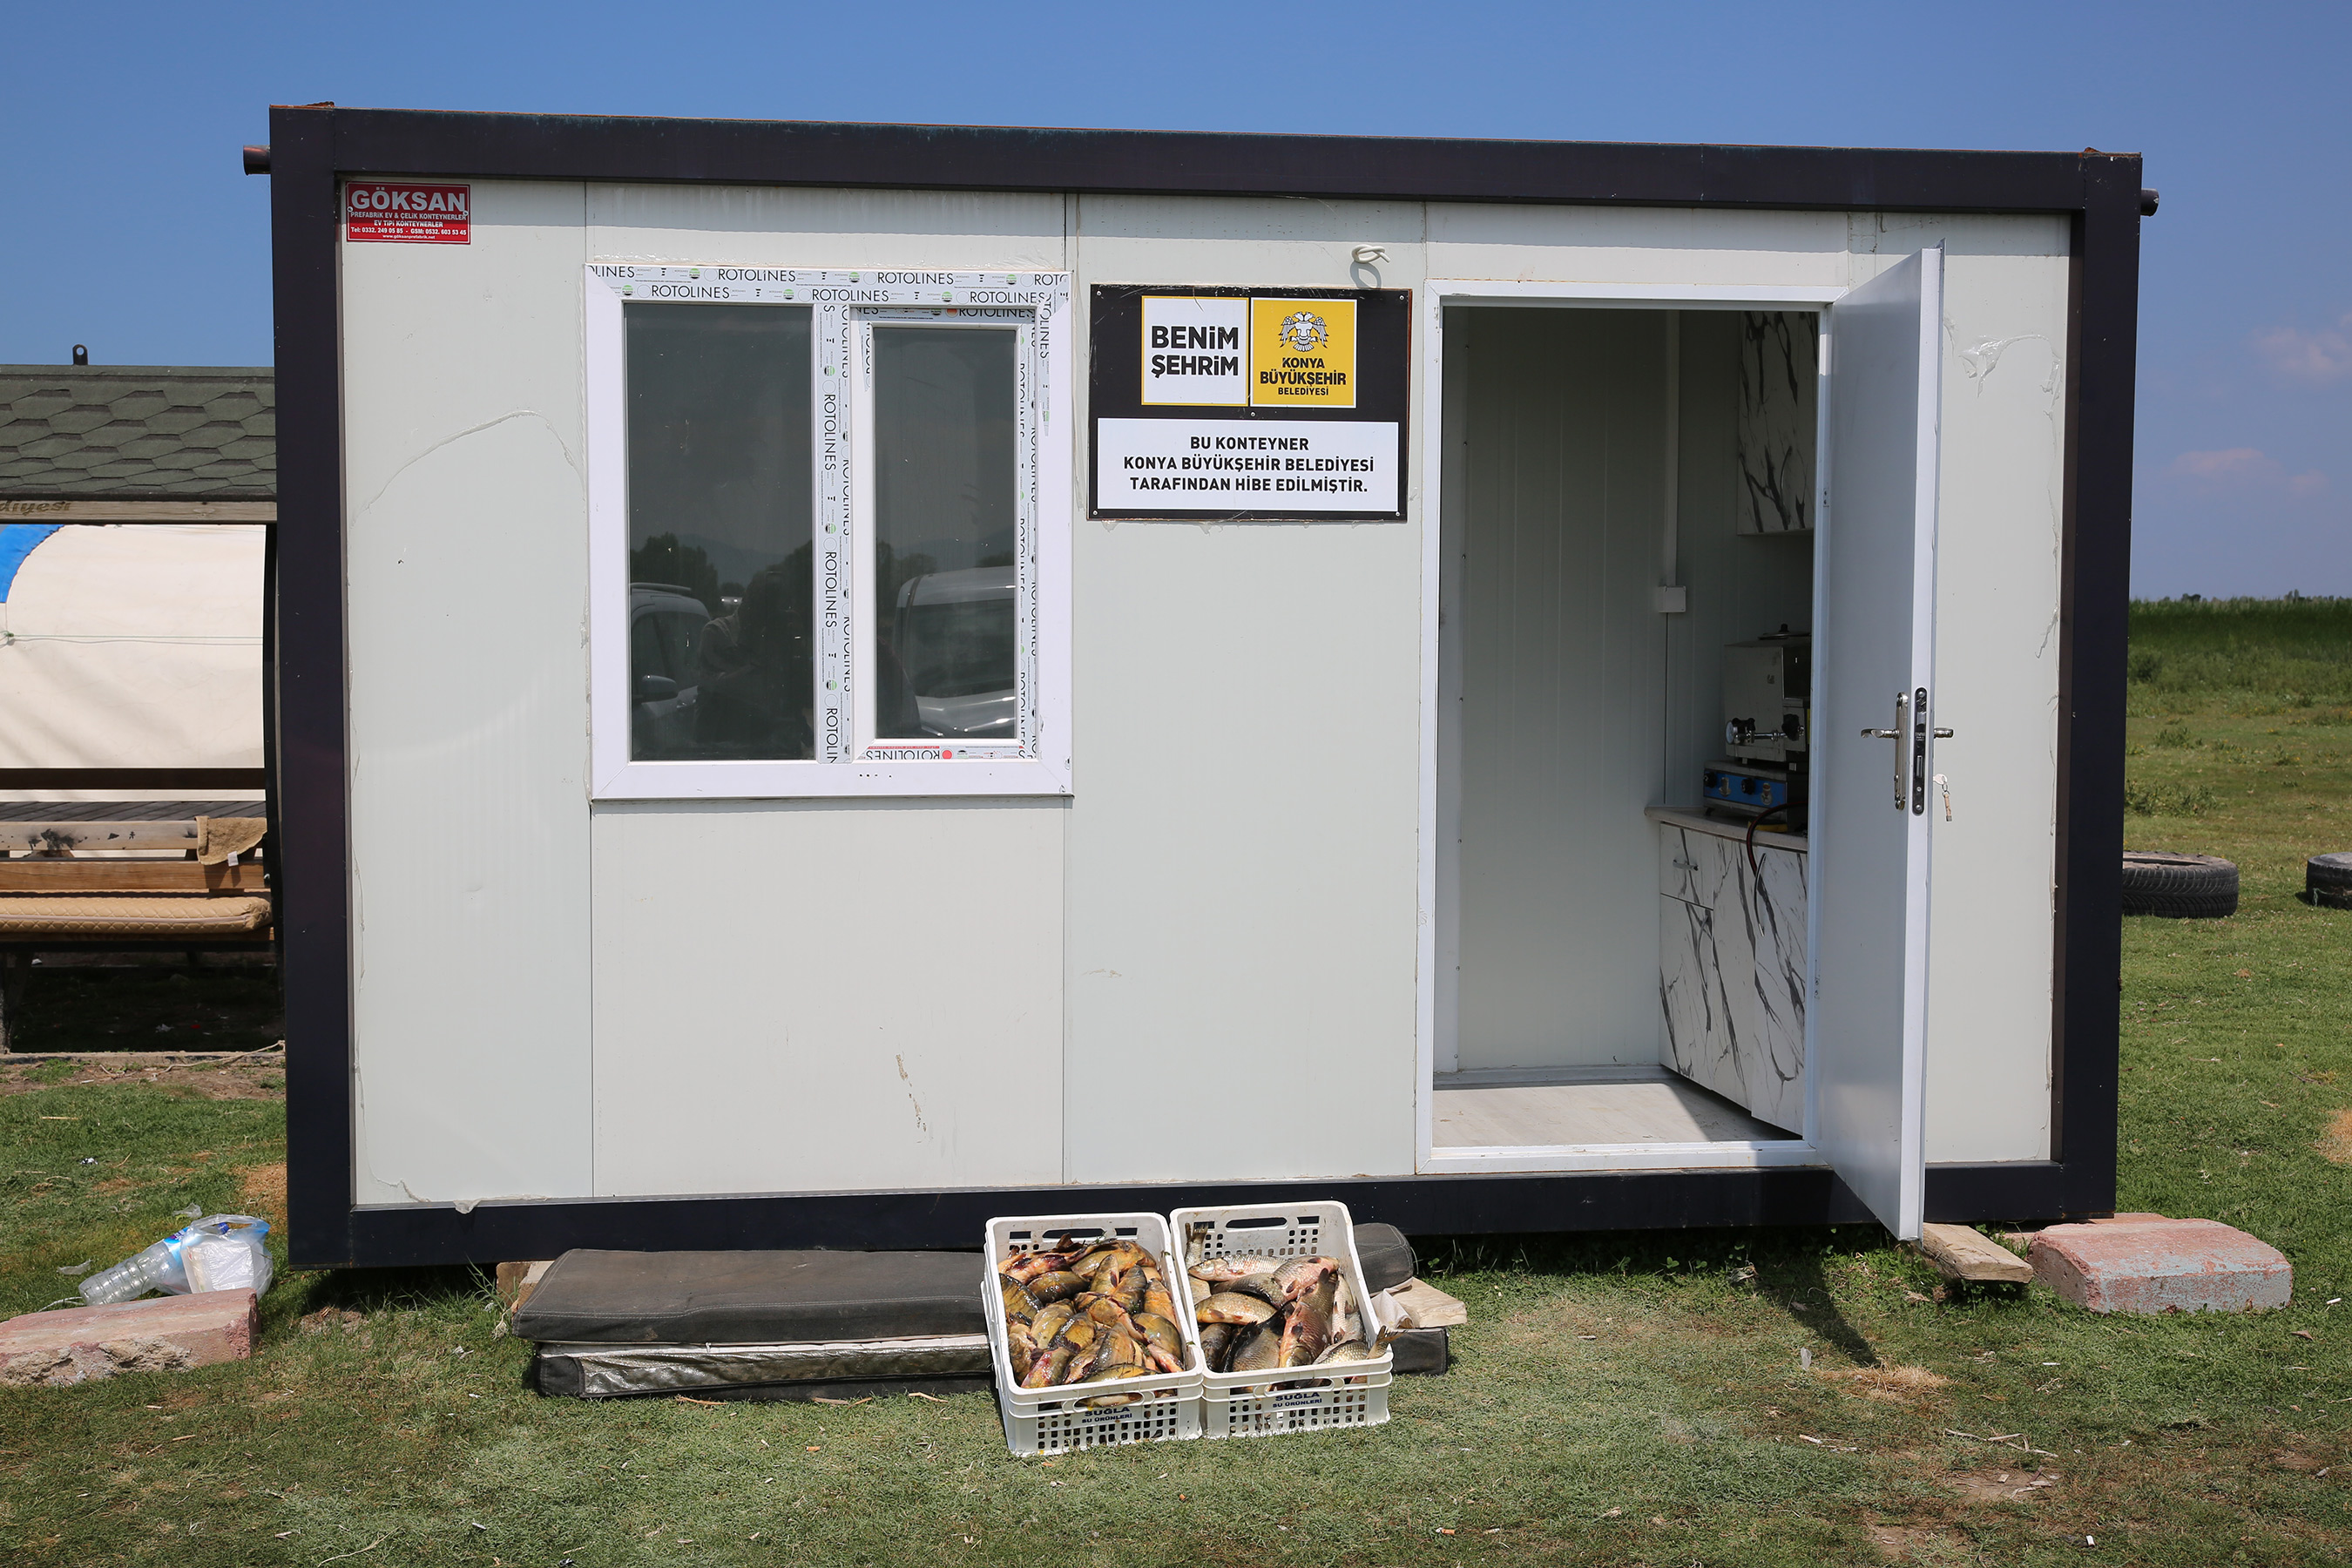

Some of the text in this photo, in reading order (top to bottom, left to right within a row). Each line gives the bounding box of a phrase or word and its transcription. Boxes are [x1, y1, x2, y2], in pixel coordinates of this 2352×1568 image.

[351, 186, 465, 212] GÖKSAN
[588, 265, 635, 278] LINES
[718, 268, 796, 282] ROTOLINES
[877, 272, 954, 285] ROTOLINES
[652, 285, 730, 299] ROTOLINES
[812, 288, 889, 302] ROTOLINES
[970, 291, 1045, 304] ROTOLINES
[1282, 357, 1325, 369] KONYA
[1260, 368, 1347, 387] BÜYÜKŞEHİR
[1278, 385, 1329, 396] BELEDİYESİ
[824, 394, 836, 470] ROTOLINES
[1191, 436, 1309, 450] BU KONTEYNER
[1124, 454, 1374, 474] KONYA BÜYÜKŞEHİR BELEDİYESİ
[1130, 475, 1368, 495] TARAFINDAN HİBE EDİLMİŞTİR.
[825, 551, 837, 628] ROTOLINES
[1275, 1392, 1321, 1402] SUĞLA
[1085, 1406, 1131, 1416] SUĞLA
